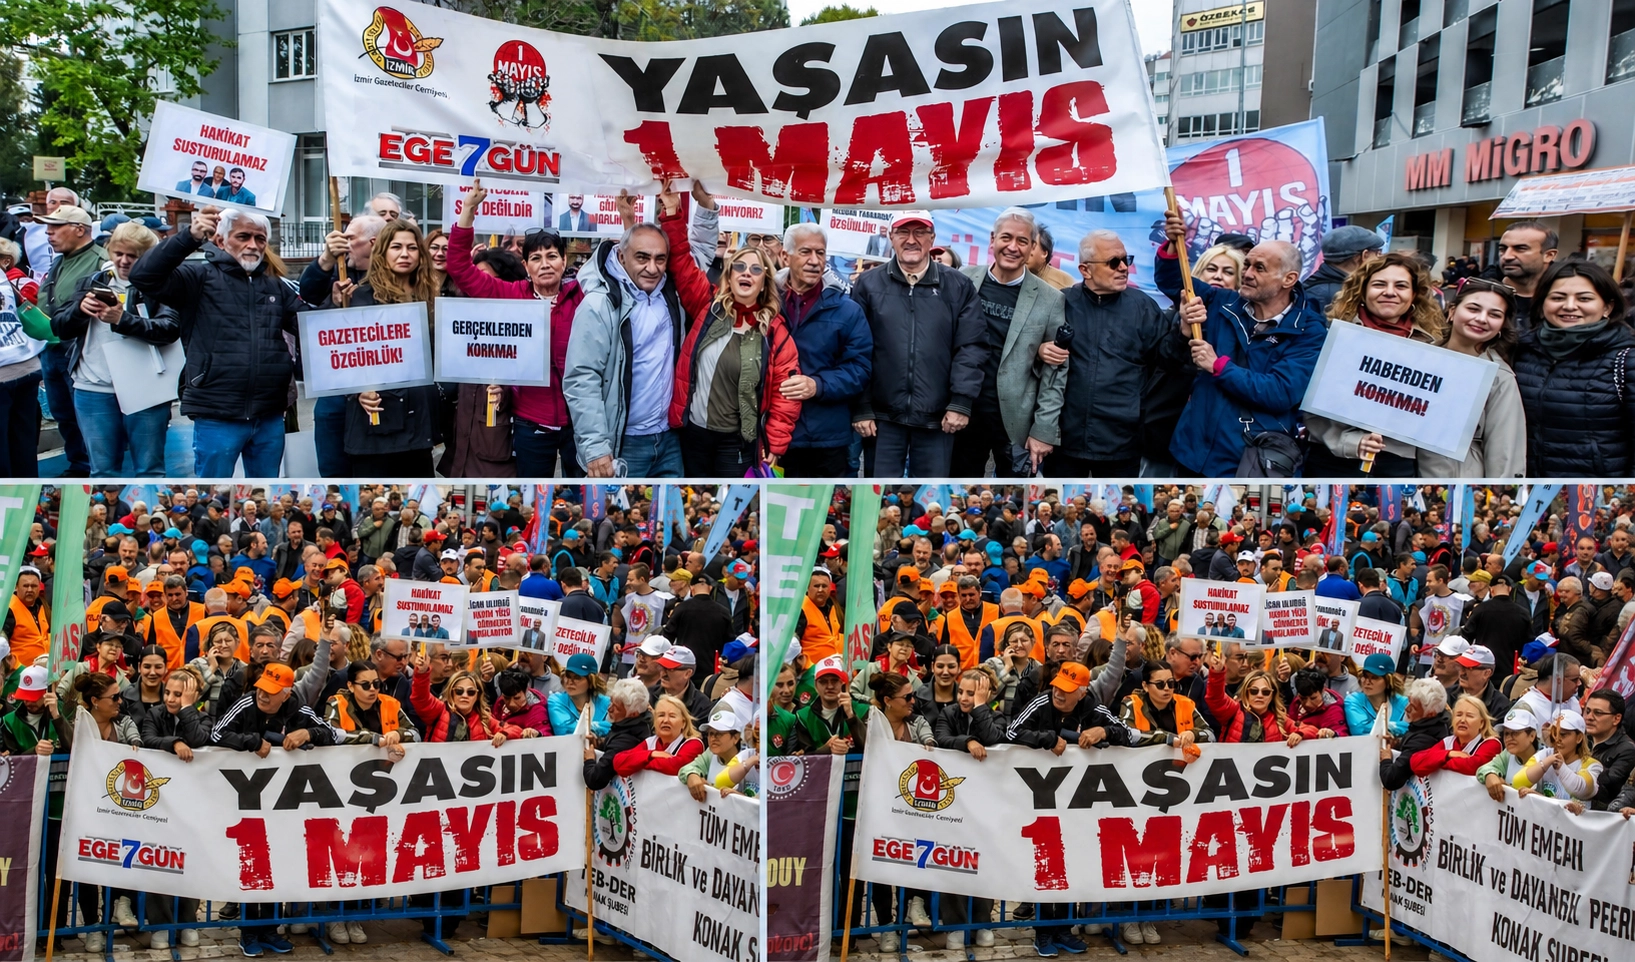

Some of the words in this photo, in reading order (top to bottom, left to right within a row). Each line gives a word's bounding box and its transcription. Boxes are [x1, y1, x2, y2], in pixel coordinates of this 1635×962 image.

[599, 7, 1103, 120] YAŞASIN
[173, 138, 268, 171] SUSTURULAMAZ
[200, 124, 251, 148] HAKİKAT
[624, 120, 690, 181] 1
[714, 80, 1117, 205] MAYIS
[1225, 148, 1243, 188] 1
[1405, 147, 1453, 191] MM
[482, 198, 532, 218] DEĞİLDİR
[1175, 181, 1307, 226] MAYIS
[318, 321, 411, 346] GAZETECİLERE
[452, 320, 533, 340] GERÇEKLERDEN
[466, 342, 518, 359] KORKMA!
[330, 345, 404, 370] ÖZGÜRLÜK!
[1359, 355, 1443, 393] HABERDEN
[1354, 380, 1429, 417] KORKMA!
[219, 751, 556, 813] YAŞASIN
[1013, 751, 1352, 814] YAŞASIN
[226, 817, 274, 890] 1
[304, 795, 559, 888] MAYIS
[699, 805, 728, 850] TÜM
[1021, 816, 1069, 891] 1
[1098, 796, 1355, 889] MAYIS
[1497, 805, 1527, 850] TÜM
[640, 835, 688, 885] BİRLİK
[692, 866, 708, 894] ve
[1437, 835, 1486, 886] BİRLİK
[1490, 867, 1506, 894] ve
[693, 910, 743, 962] KONAK
[1491, 911, 1543, 962] KONAK
